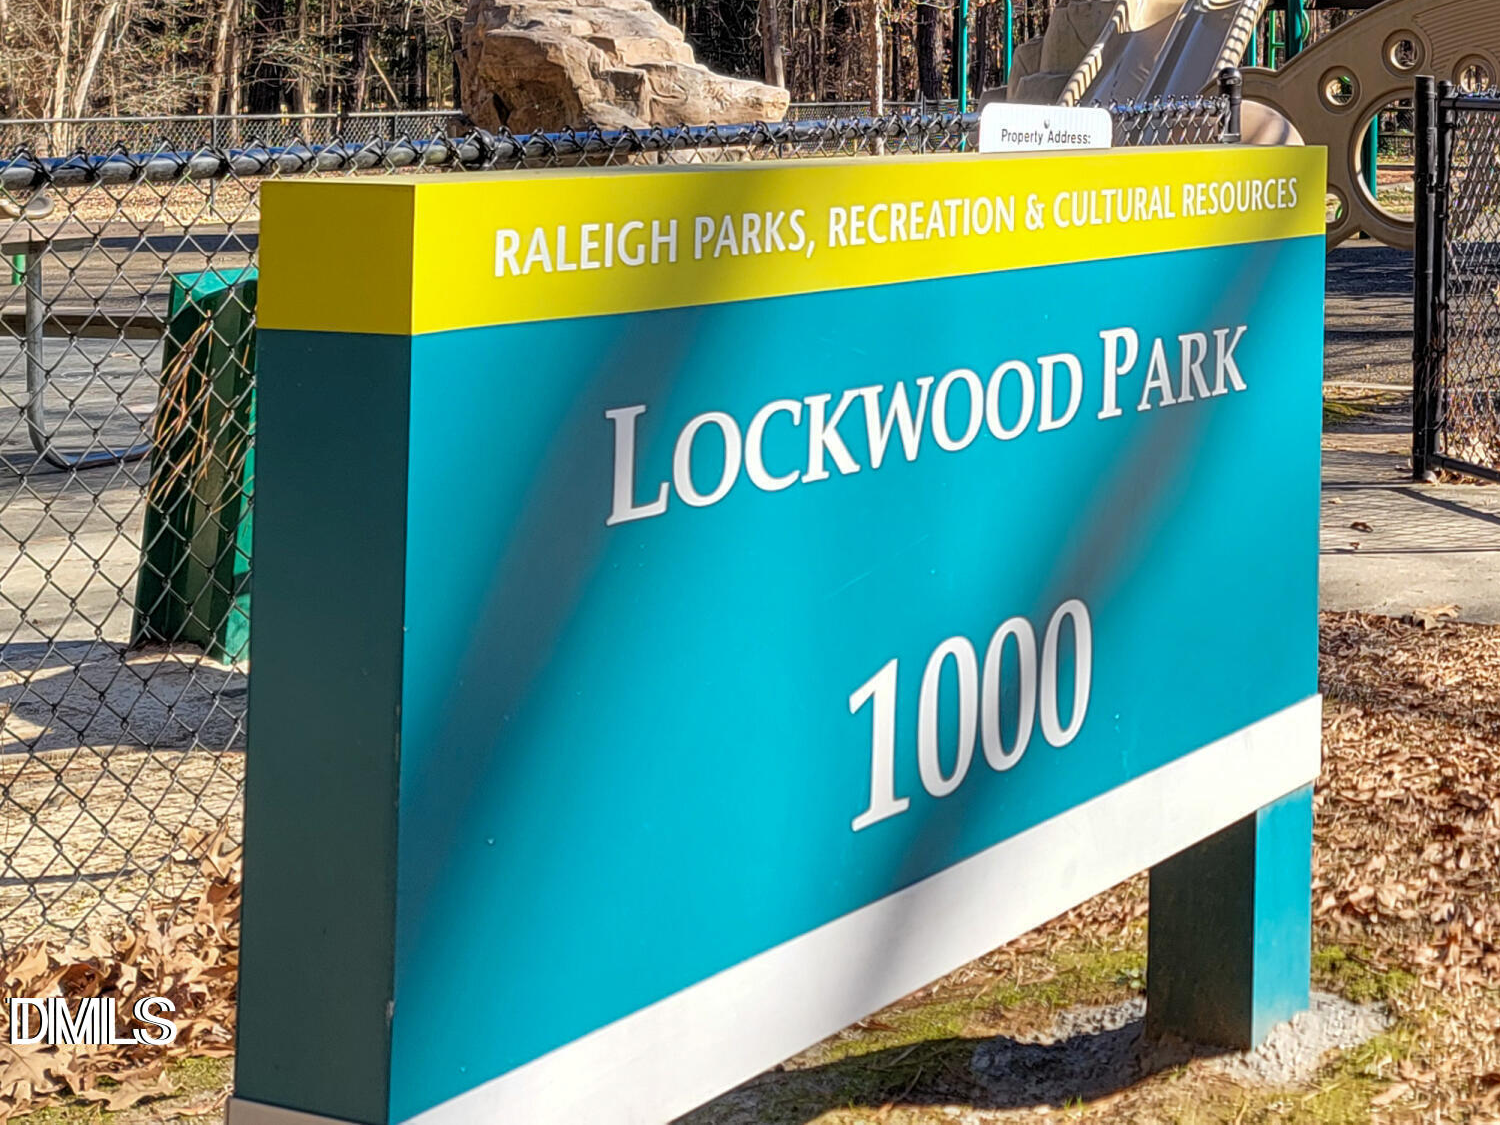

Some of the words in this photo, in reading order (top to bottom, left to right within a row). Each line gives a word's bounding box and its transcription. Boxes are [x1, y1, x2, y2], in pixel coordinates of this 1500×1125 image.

[1001, 128, 1044, 145] Property
[1048, 130, 1091, 145] Address:
[494, 219, 678, 277] RALEIGH
[694, 209, 815, 259] PARKS,
[828, 195, 1014, 248] RECREATION
[1025, 193, 1044, 231] &
[1053, 185, 1176, 228] CULTURAL
[1182, 177, 1298, 215] RESOURCES
[848, 599, 1093, 832] 1000
